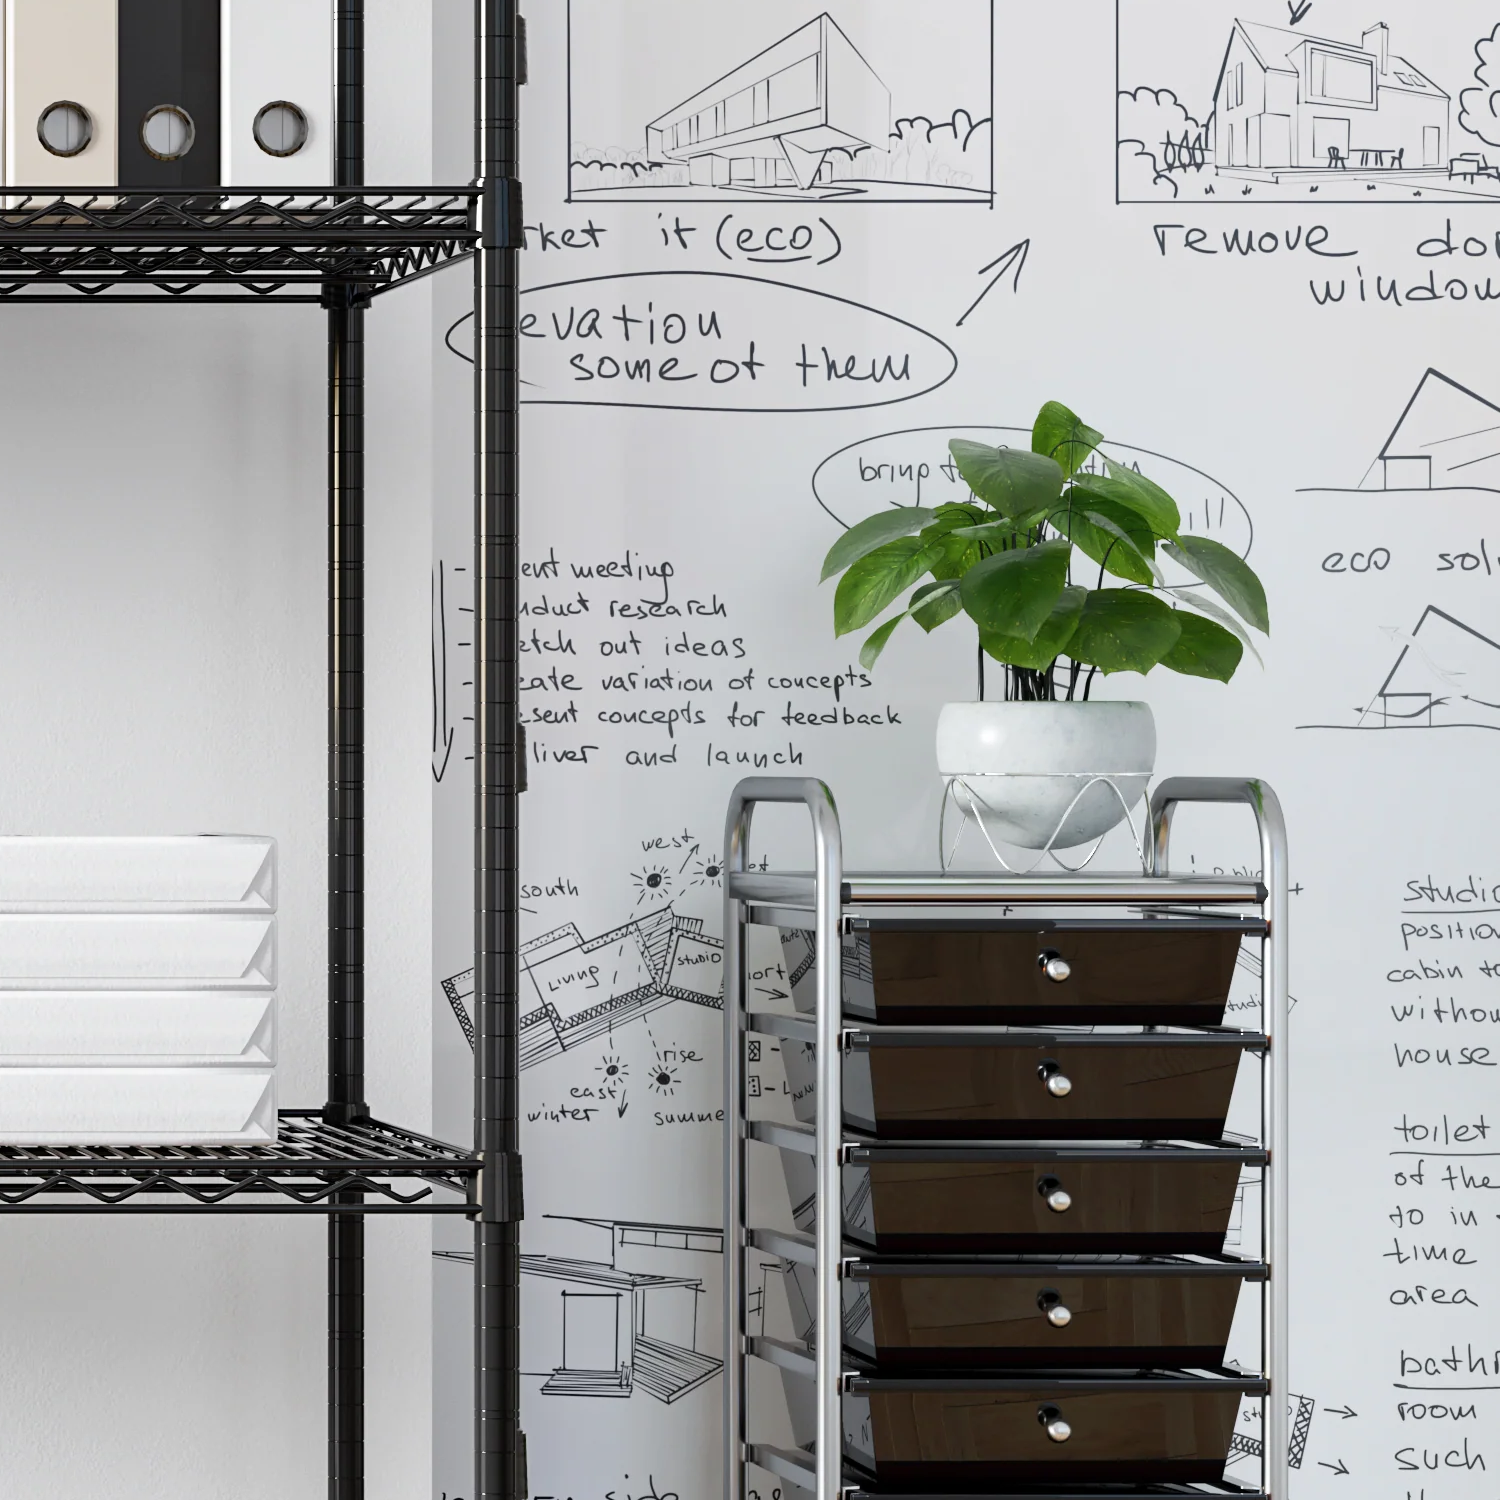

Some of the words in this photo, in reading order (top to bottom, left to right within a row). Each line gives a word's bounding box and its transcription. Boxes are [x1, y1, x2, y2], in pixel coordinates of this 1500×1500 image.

[522, 219, 608, 252] rket
[657, 212, 697, 250] it
[1152, 224, 1359, 258] remove
[518, 301, 722, 346] evation
[569, 353, 699, 384] some
[708, 336, 767, 384] of
[794, 333, 914, 385] them
[521, 546, 561, 579] ent
[1321, 547, 1391, 573] eco
[1436, 538, 1500, 576] sol
[519, 591, 590, 617] nduct
[608, 594, 729, 621] research
[519, 627, 577, 656] etch
[599, 630, 642, 657] out
[665, 631, 746, 659] ideas
[519, 665, 583, 692] eate
[601, 664, 713, 692] variation
[728, 667, 755, 691] of
[767, 667, 874, 702] concepts
[597, 700, 707, 739] concepts
[726, 700, 766, 728] for
[780, 702, 903, 728] feedback
[533, 741, 600, 764] liver
[625, 743, 677, 767] and
[707, 741, 803, 769] launch
[641, 827, 696, 852] west
[519, 876, 579, 899] south
[1400, 921, 1500, 952] positio
[1386, 959, 1464, 983] cabin
[1393, 1042, 1498, 1068] house
[527, 1102, 600, 1123] winter
[654, 1109, 725, 1126] summe
[1393, 1113, 1491, 1146] toilet
[1394, 1158, 1425, 1187] of
[1441, 1164, 1500, 1191] the
[1388, 1205, 1424, 1229] to
[1449, 1205, 1479, 1228] in
[1382, 1237, 1478, 1265] time
[1389, 1285, 1479, 1308] area
[1397, 1401, 1477, 1422] room
[1394, 1436, 1486, 1472] such
